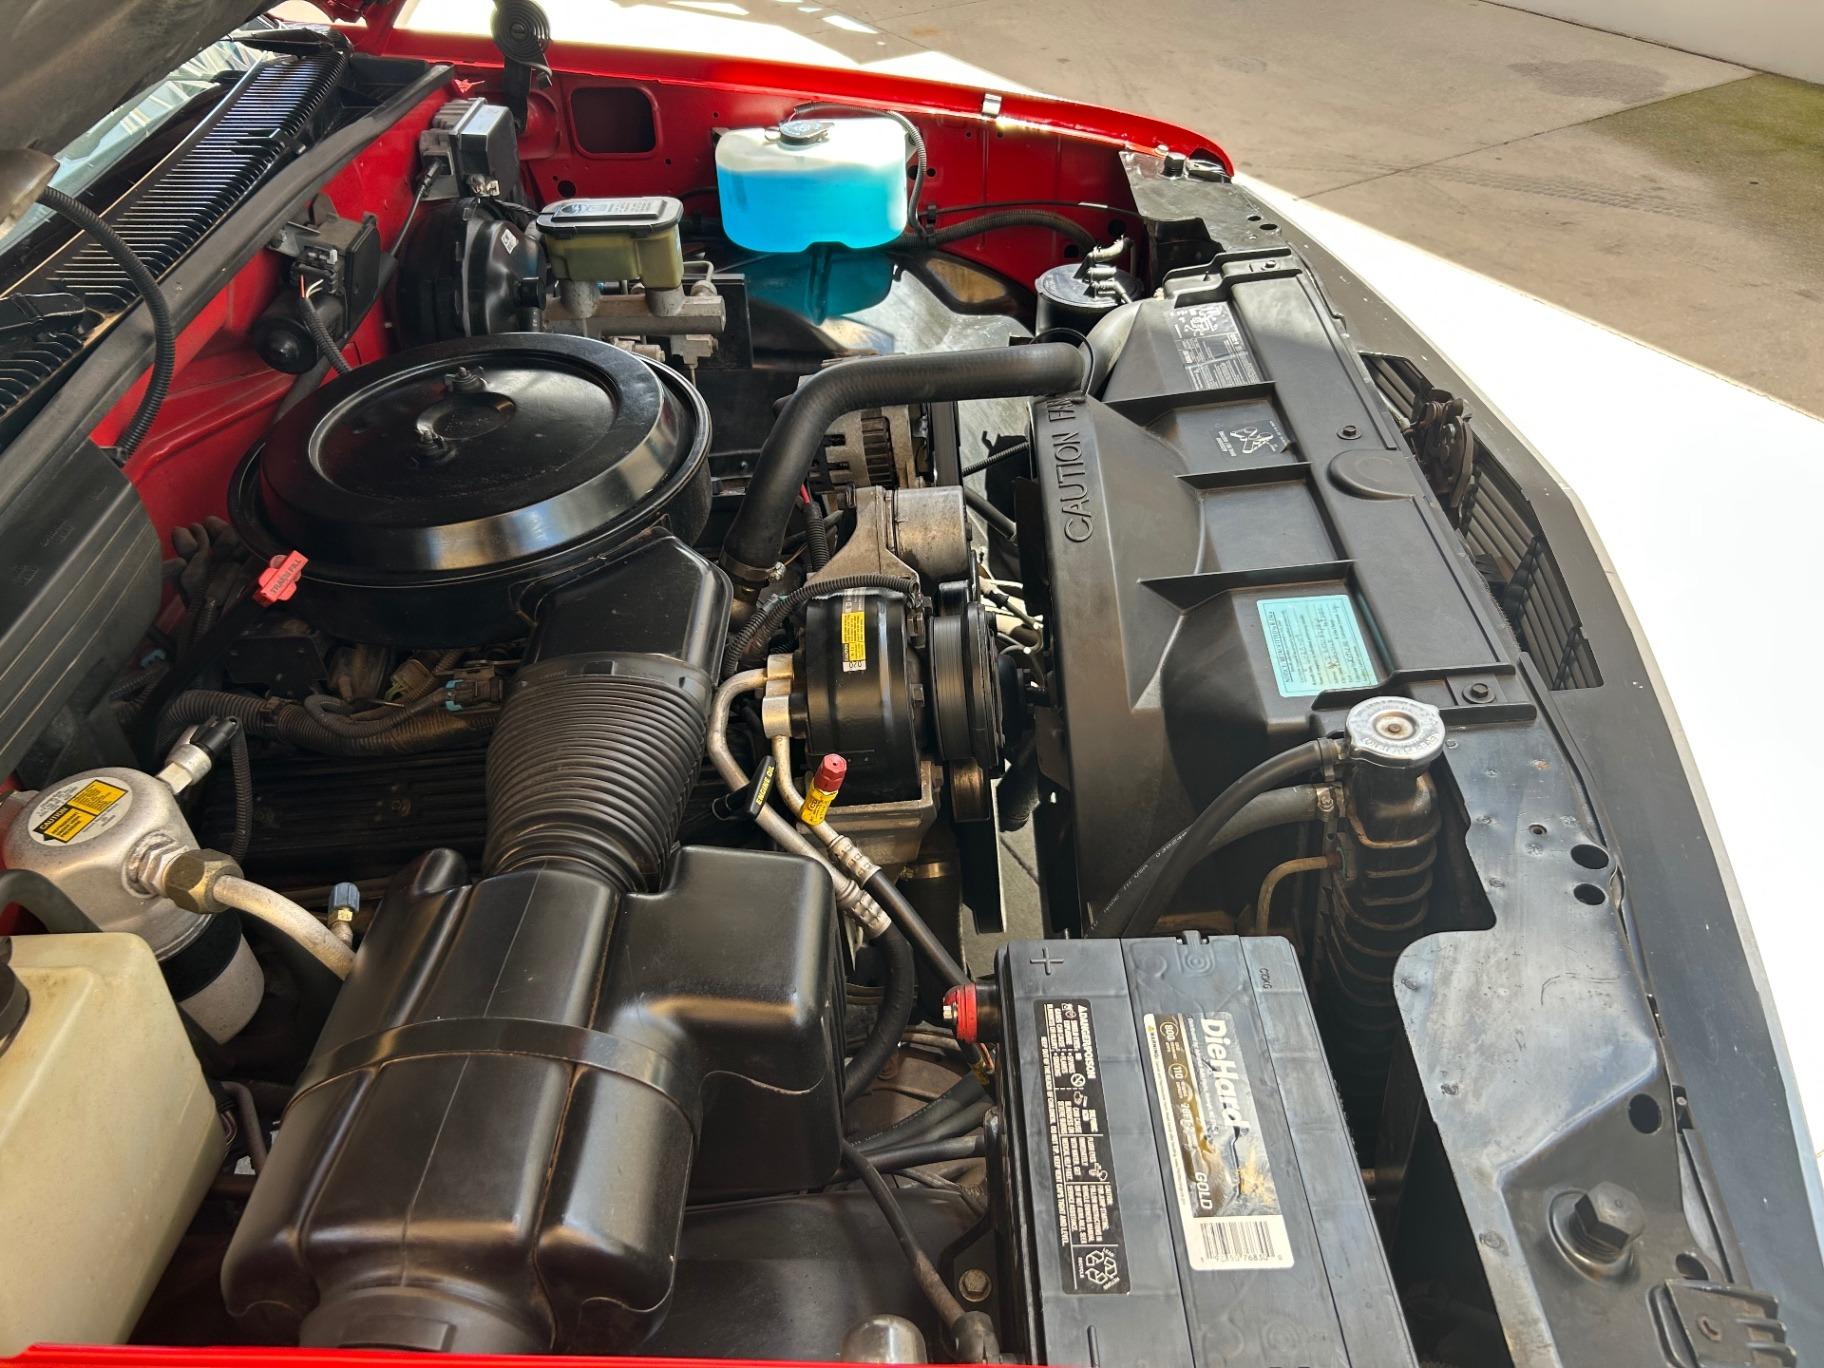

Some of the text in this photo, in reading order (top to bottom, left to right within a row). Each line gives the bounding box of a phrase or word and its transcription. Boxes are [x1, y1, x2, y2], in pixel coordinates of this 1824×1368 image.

[1052, 431, 1094, 542] CAUTION
[755, 776, 771, 805] ENGINE
[38, 806, 69, 830] CAUTION
[1078, 1013, 1096, 1078] DANGER/POISON
[1163, 1024, 1176, 1040] 800
[1172, 1066, 1183, 1078] 110
[1200, 1018, 1251, 1127] DieHard
[1194, 1171, 1213, 1209] GOLD
